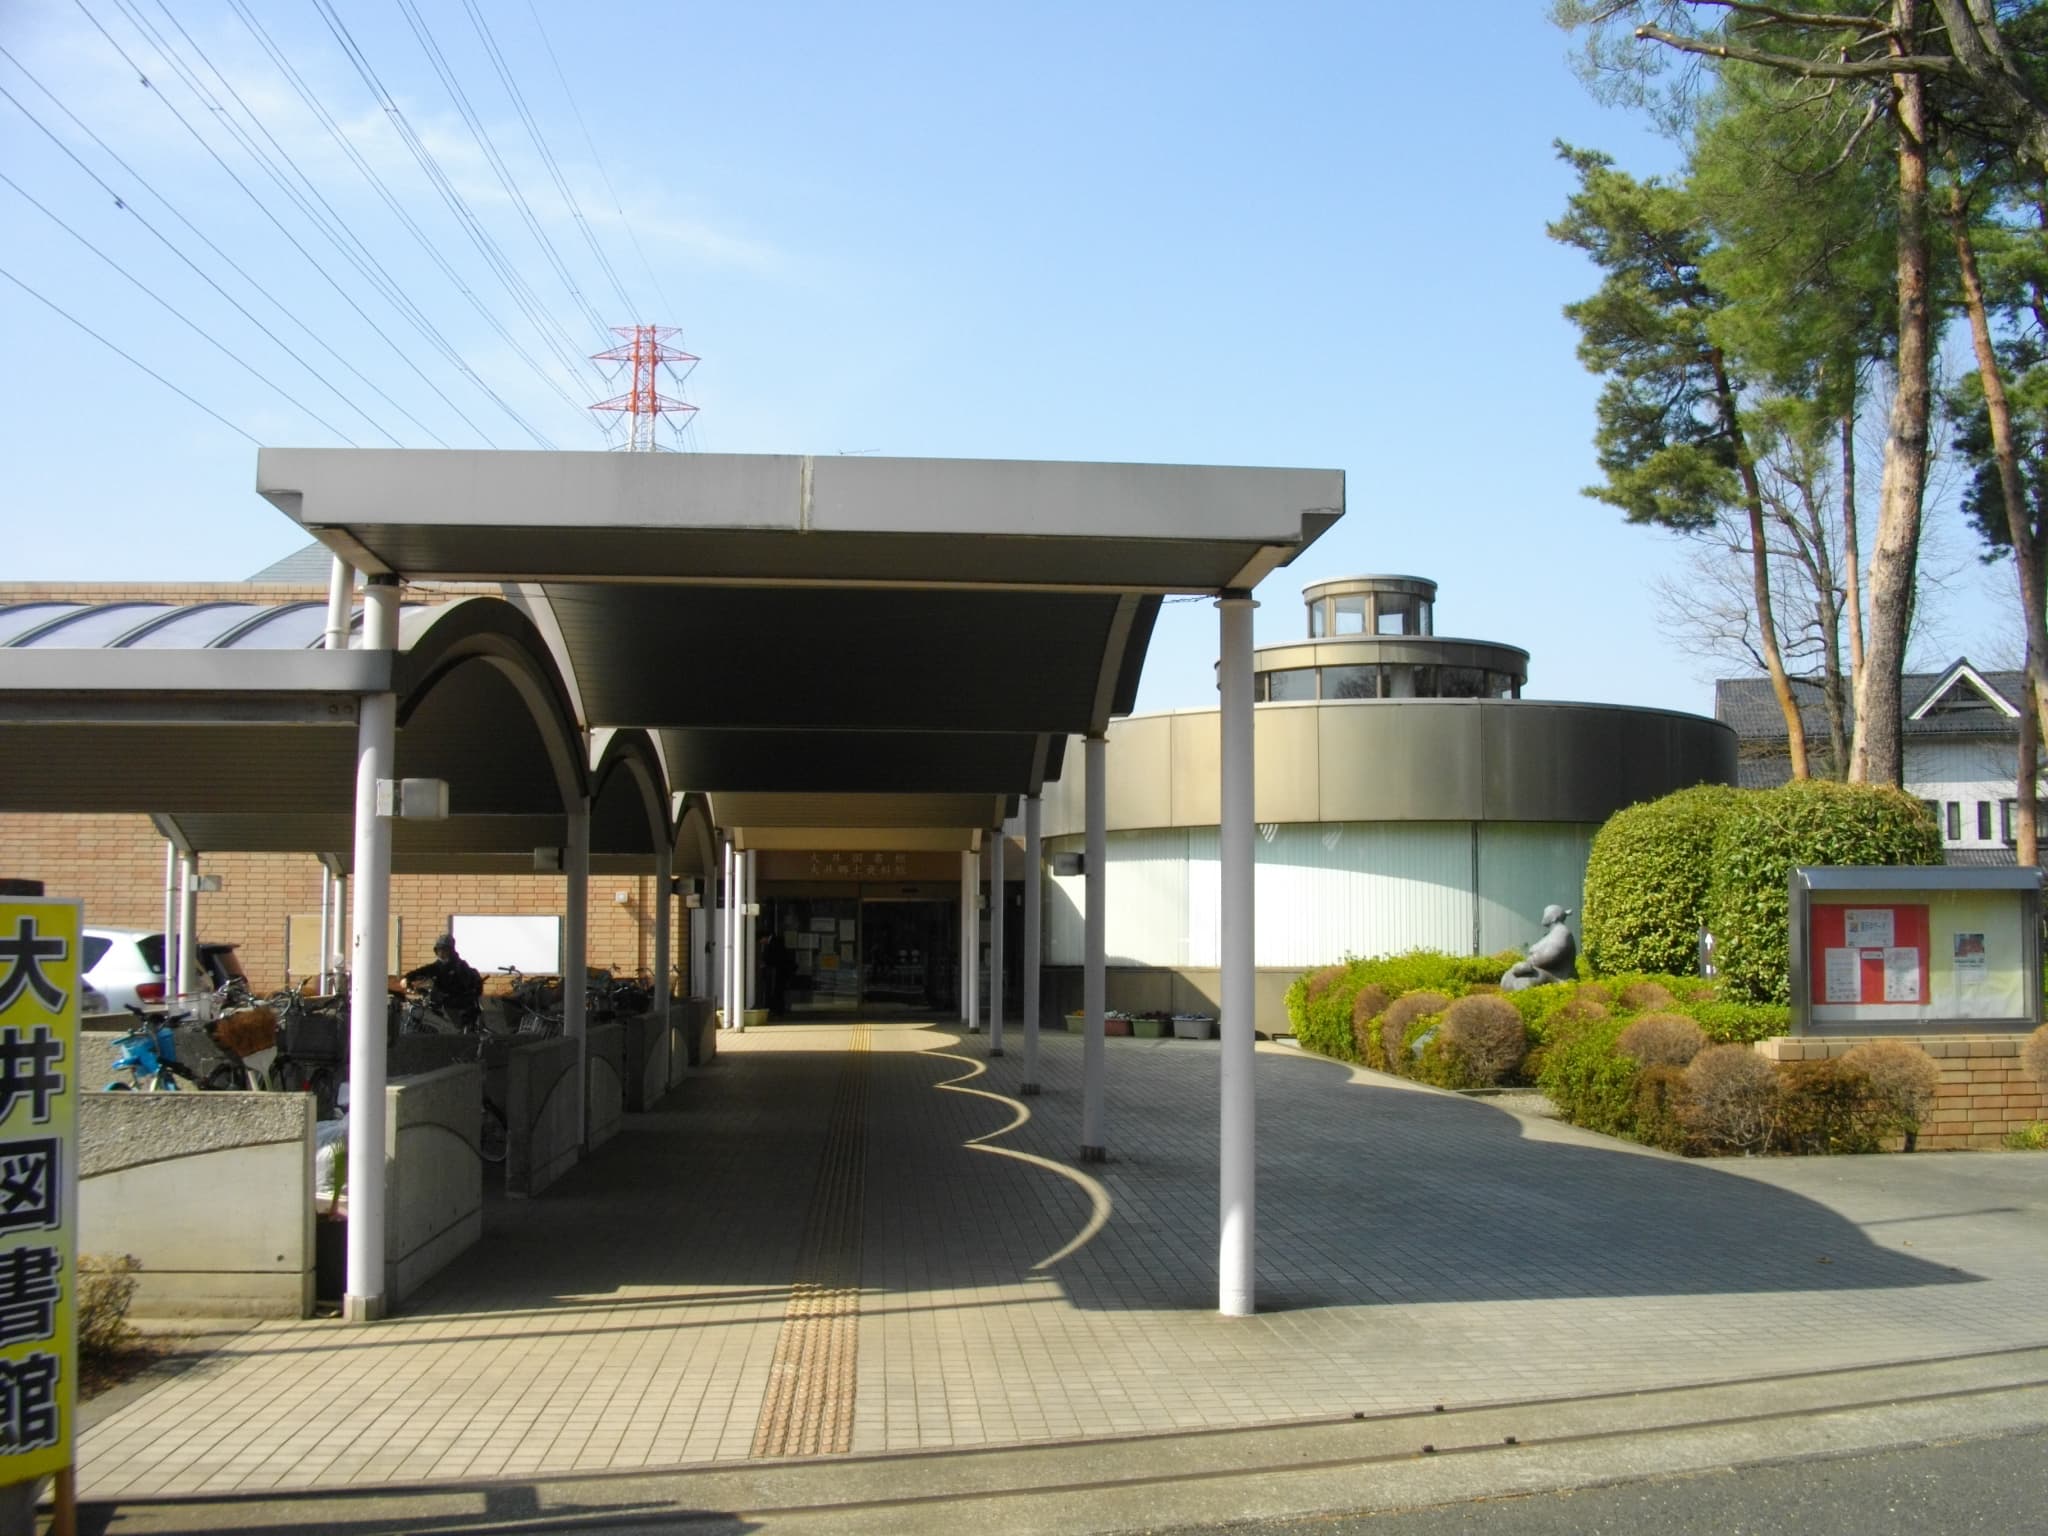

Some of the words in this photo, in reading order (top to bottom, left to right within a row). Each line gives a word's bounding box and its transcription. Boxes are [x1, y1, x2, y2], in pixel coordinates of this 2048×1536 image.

[0, 915, 68, 1455] 大井図書館
